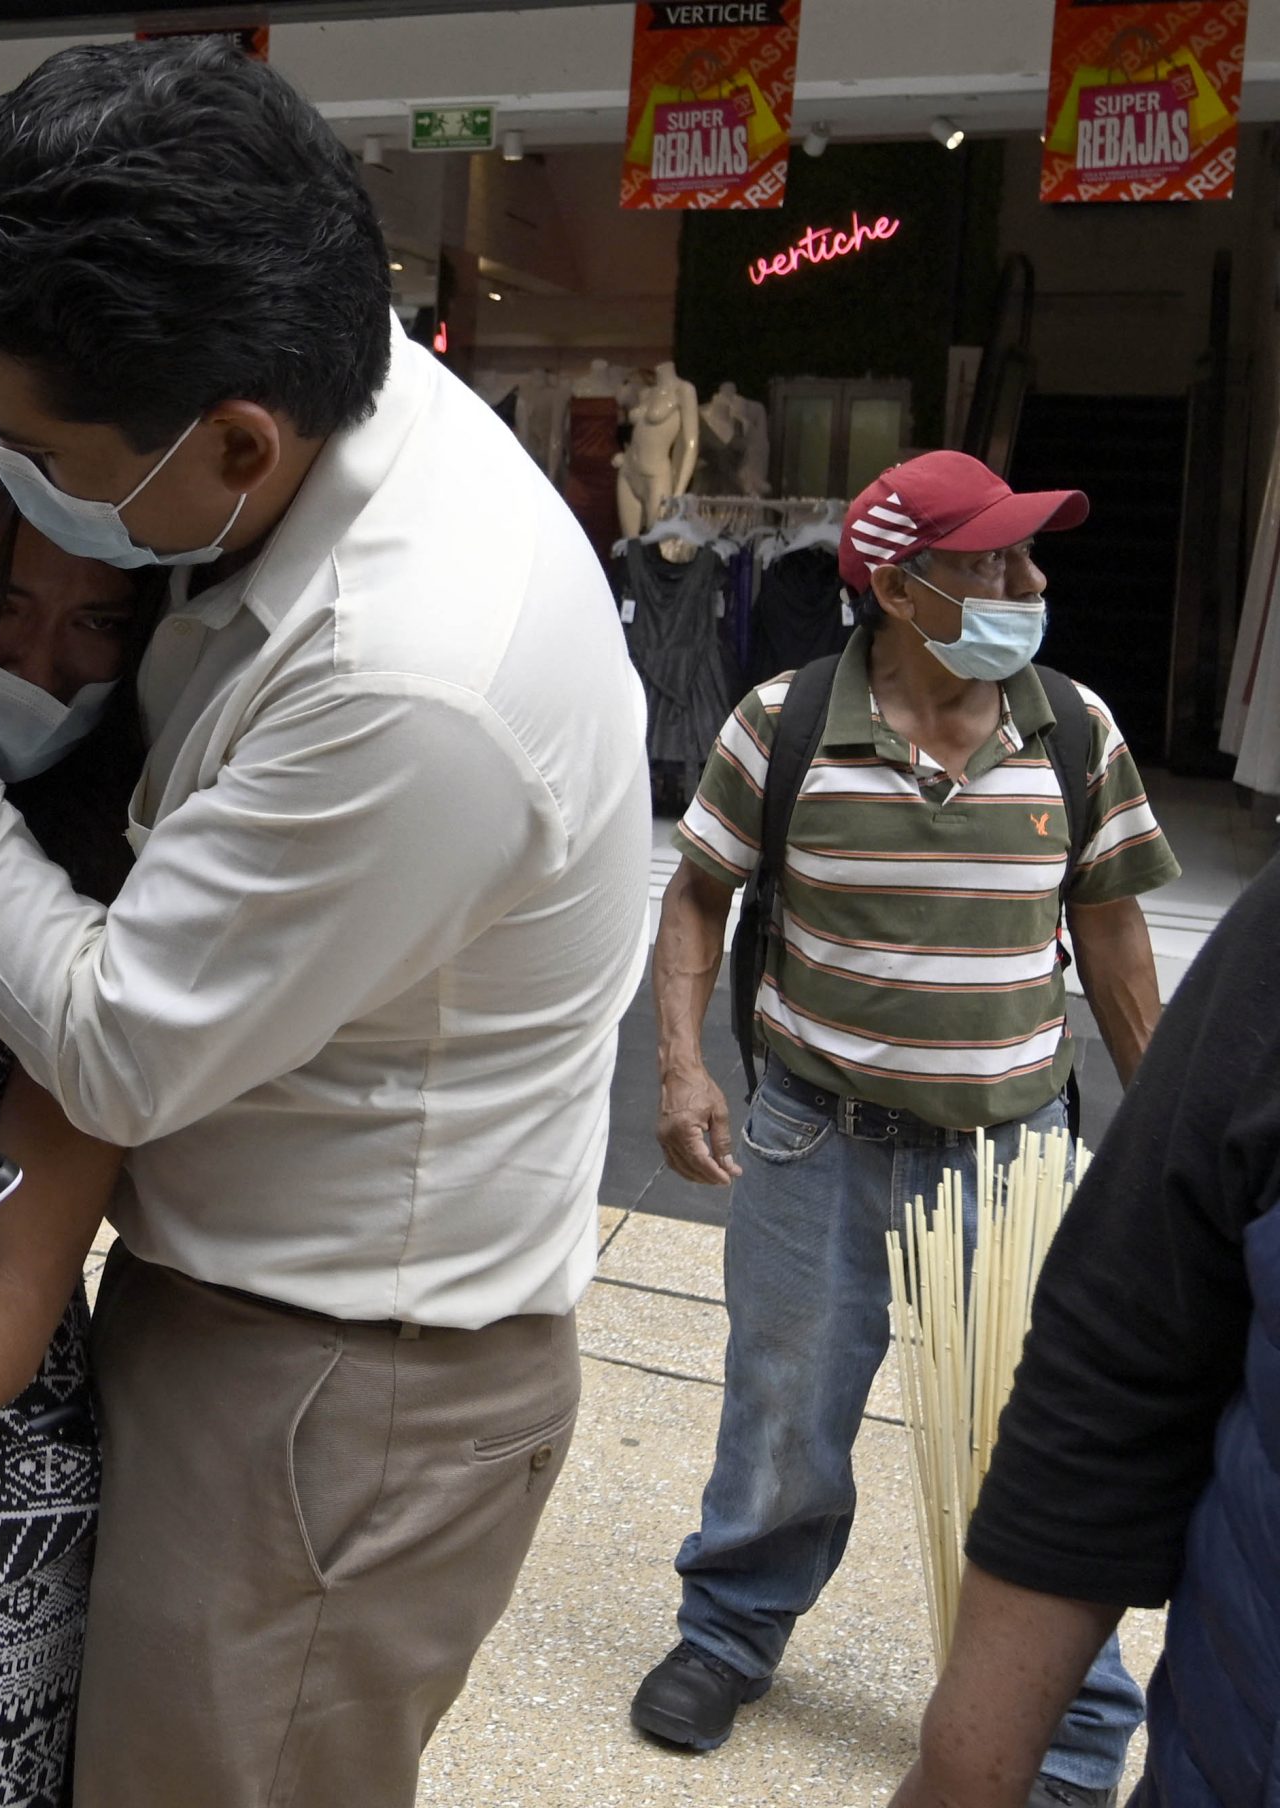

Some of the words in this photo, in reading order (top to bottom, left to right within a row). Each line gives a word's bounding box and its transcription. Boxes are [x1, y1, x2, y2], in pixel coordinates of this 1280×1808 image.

[666, 3, 769, 25] VERTICHE
[667, 109, 725, 131] SUPER
[1094, 91, 1161, 117] SUPER
[651, 125, 749, 180] REBAJAS
[1076, 109, 1190, 170] REBAJAS
[748, 210, 900, 285] vertiche
